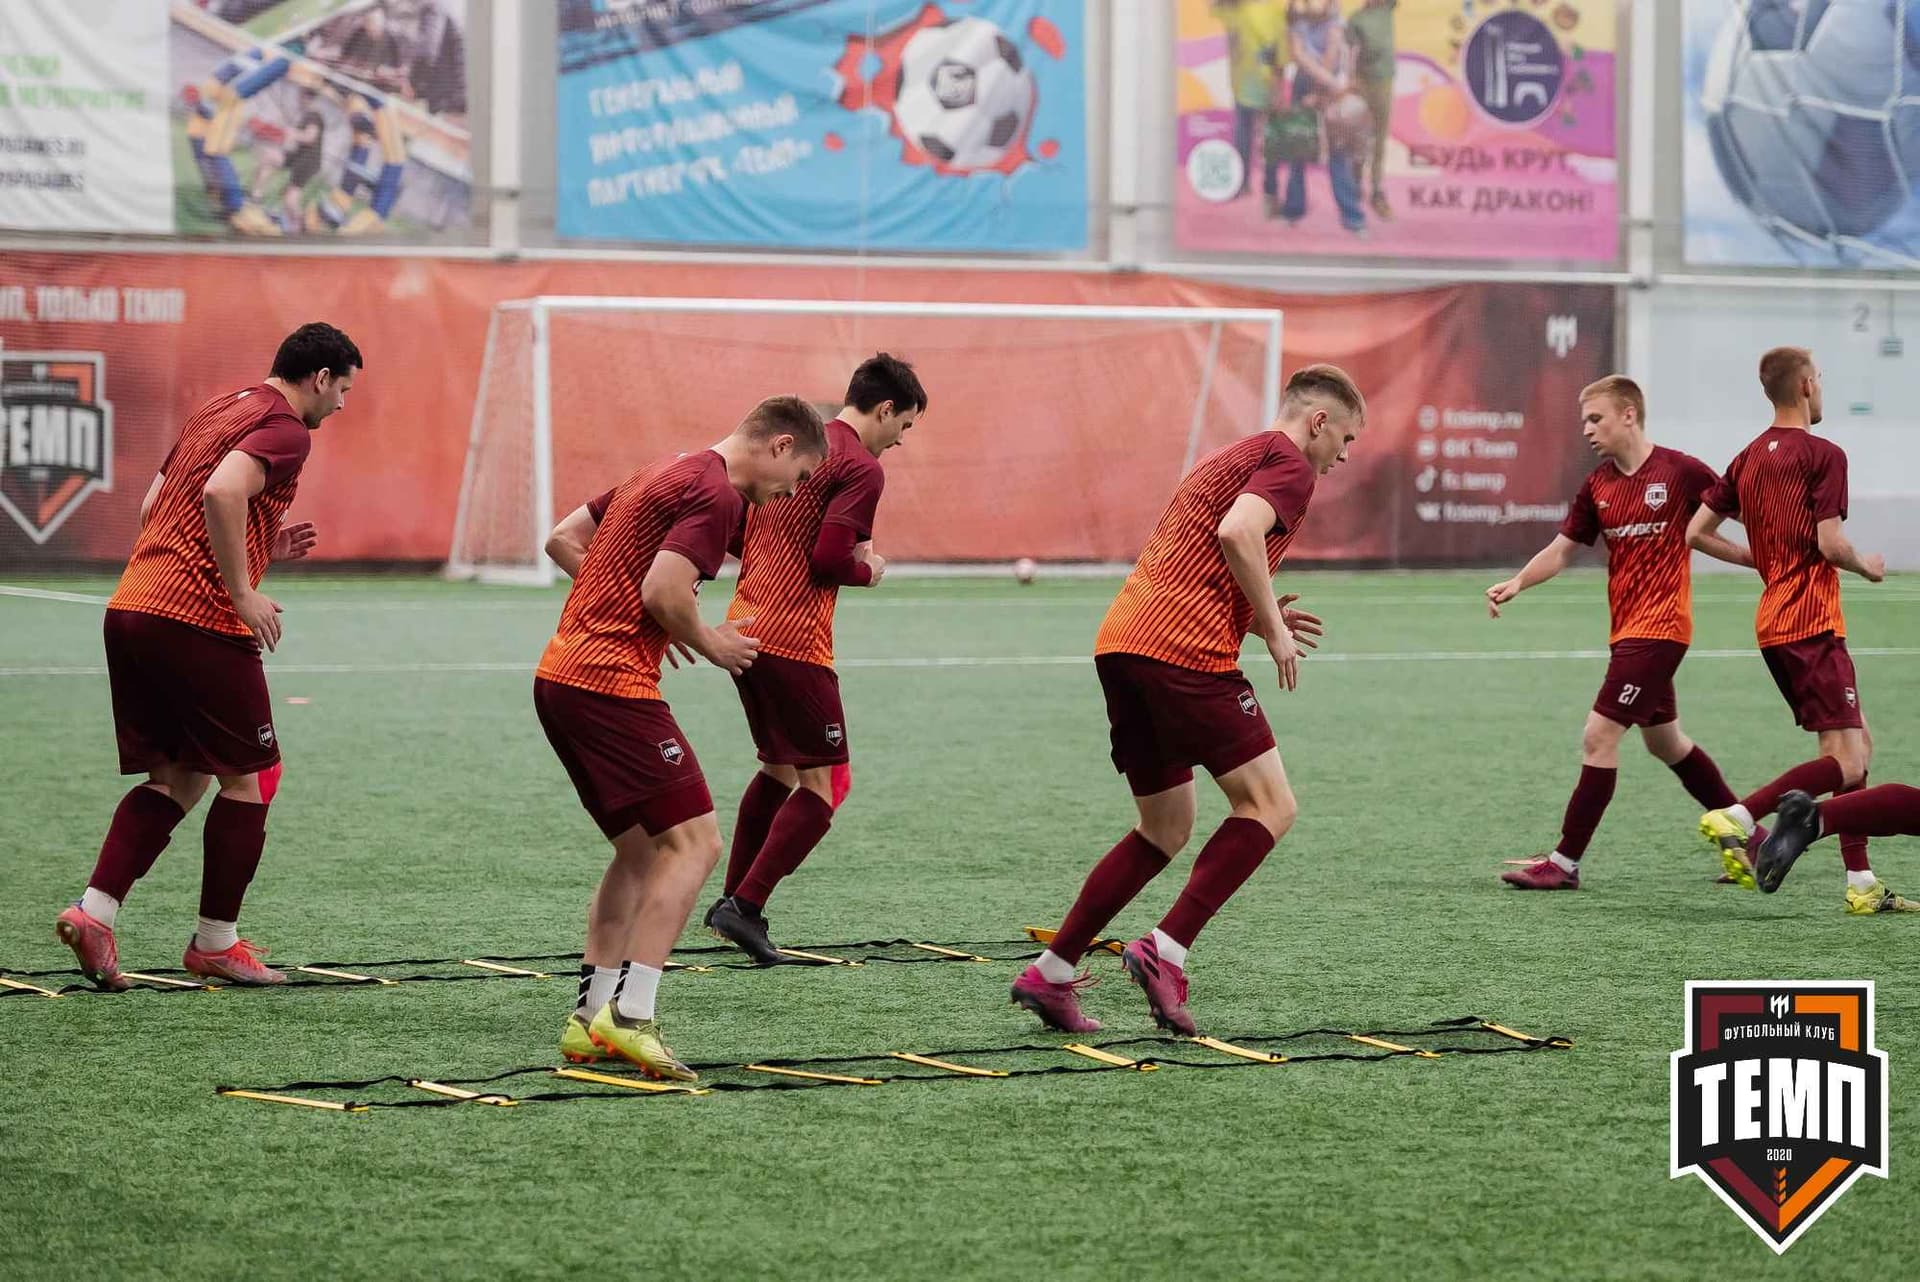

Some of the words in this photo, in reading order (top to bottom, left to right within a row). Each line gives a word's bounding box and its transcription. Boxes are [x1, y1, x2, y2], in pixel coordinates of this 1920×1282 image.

[1409, 186, 1466, 209] КАК
[36, 286, 118, 322] ТОЛЬКО
[123, 287, 186, 323] ТЕМП
[1853, 301, 1871, 332] 2
